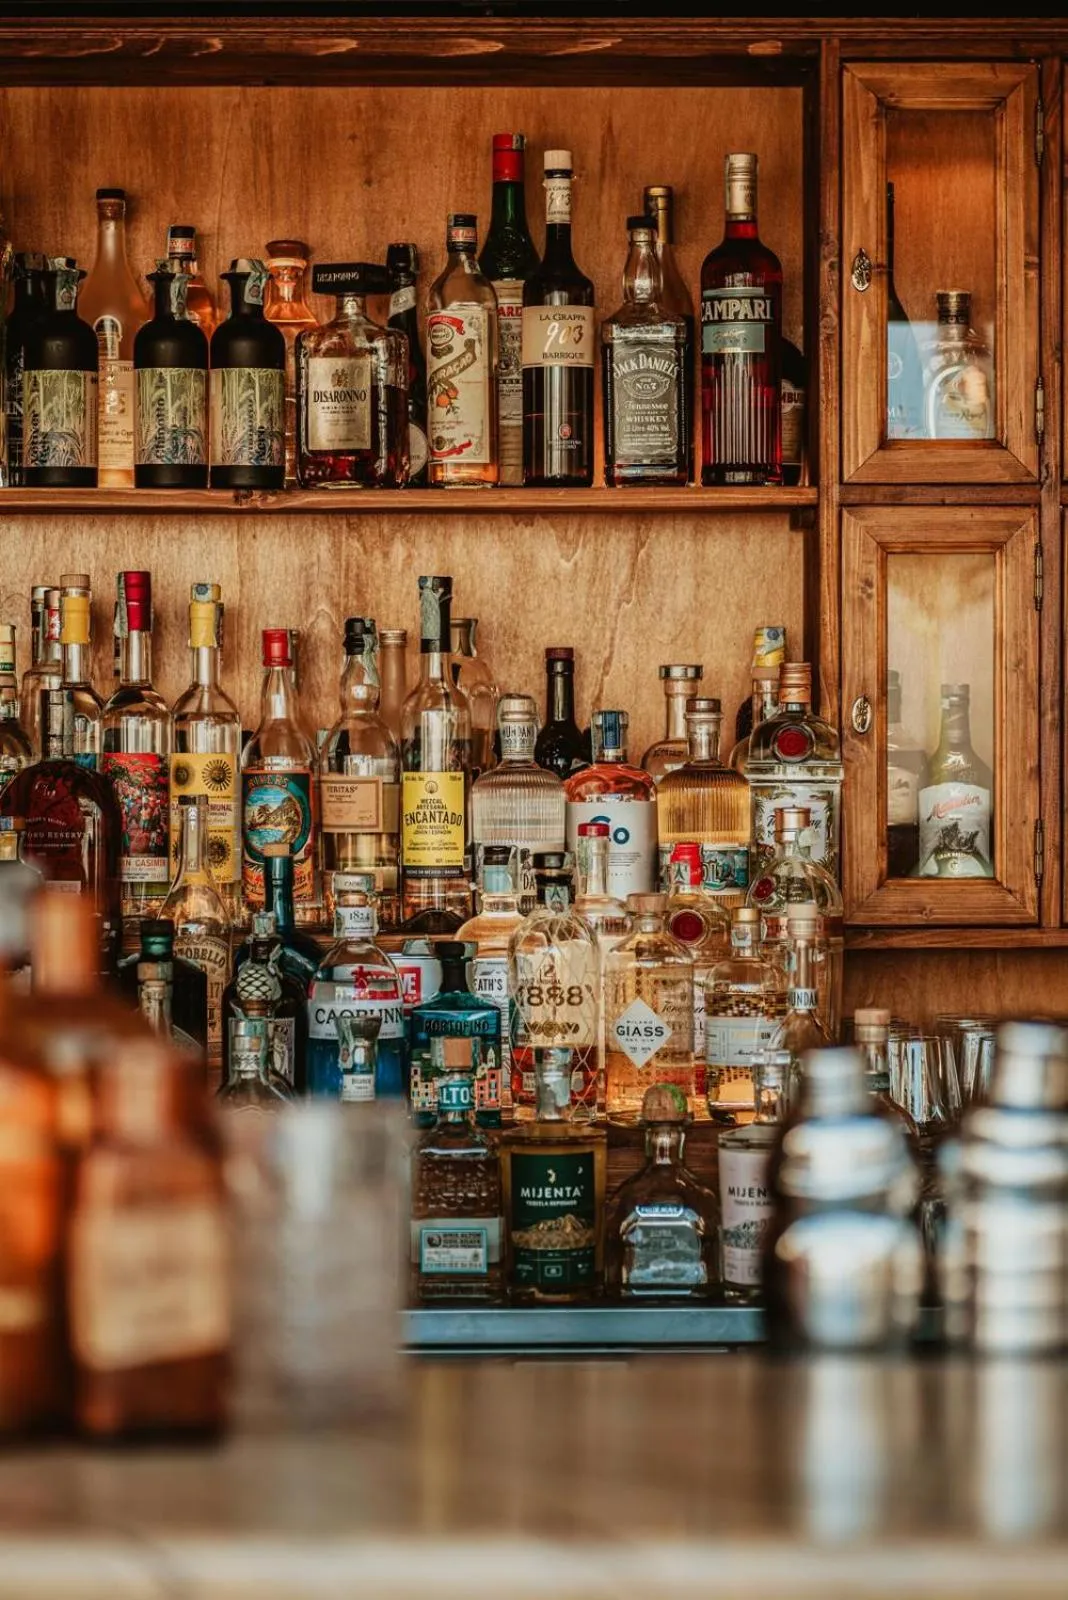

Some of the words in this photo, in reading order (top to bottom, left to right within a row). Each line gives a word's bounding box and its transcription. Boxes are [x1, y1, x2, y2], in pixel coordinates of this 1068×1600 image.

[316, 271, 360, 283] DISARONNO
[552, 312, 586, 321] GRAPPA
[544, 321, 584, 352] 903
[542, 351, 585, 360] BARRIQUE
[613, 358, 640, 379] JACK
[313, 390, 367, 403] DISARONNO
[248, 774, 290, 789] RIVERS
[404, 810, 463, 827] ENCANTADO
[616, 1025, 665, 1037] GIASS
[520, 1187, 582, 1199] MIJENTA
